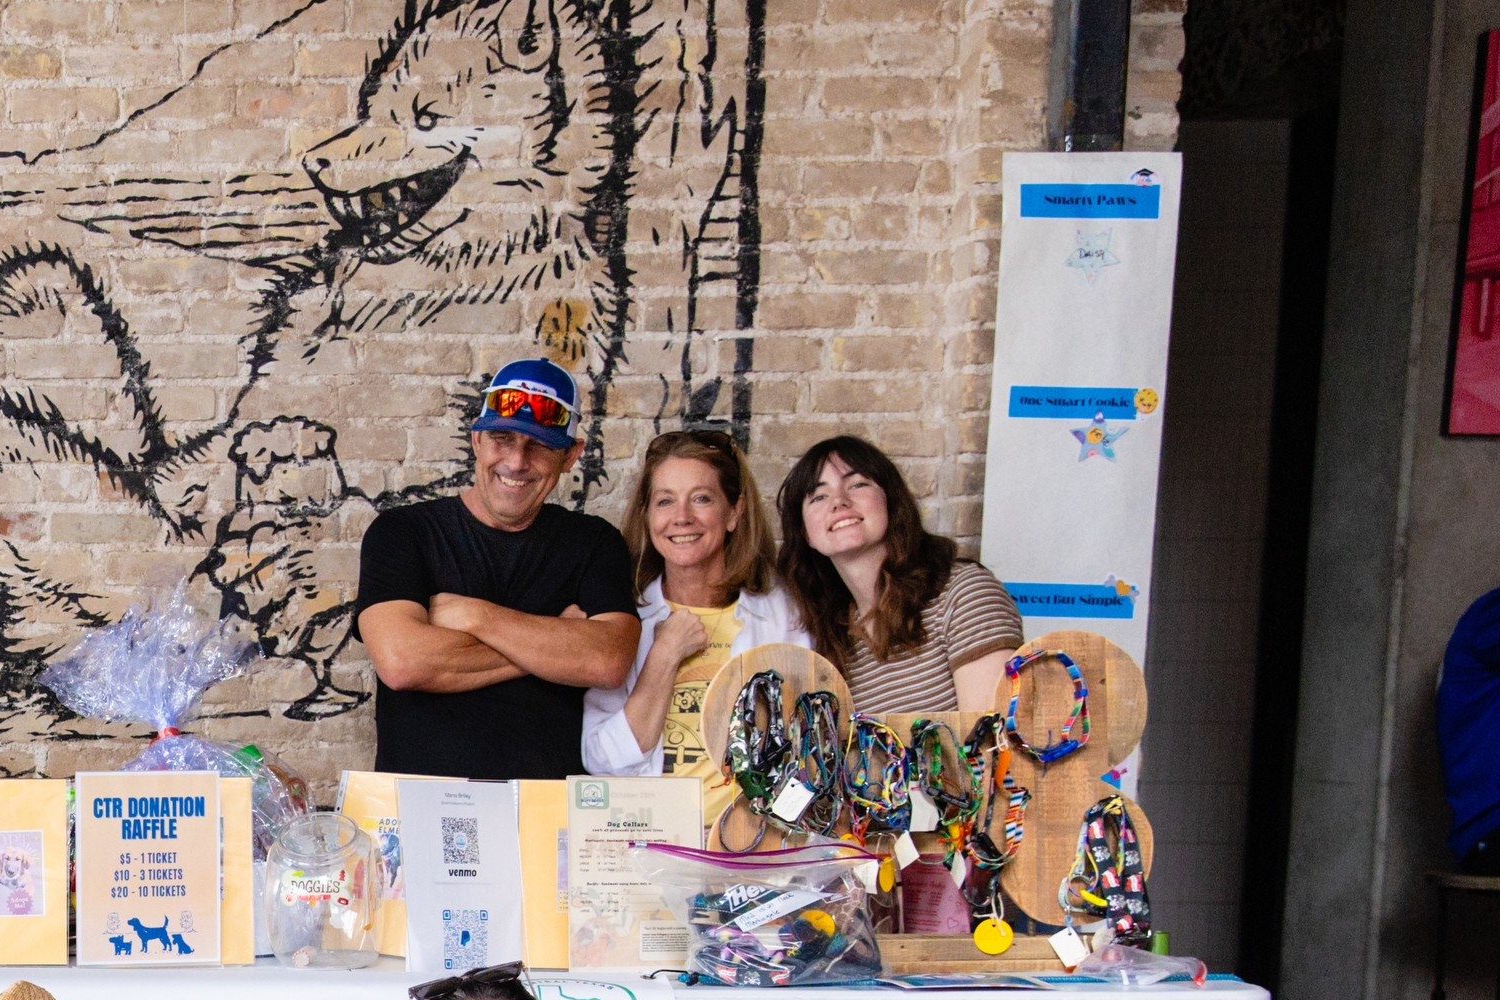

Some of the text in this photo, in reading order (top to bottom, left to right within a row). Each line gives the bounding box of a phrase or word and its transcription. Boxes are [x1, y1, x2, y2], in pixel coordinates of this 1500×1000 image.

[1043, 195, 1137, 208] Smarty Paws
[1019, 396, 1130, 408] One Smart Cookie
[1053, 594, 1076, 605] But
[1078, 594, 1125, 607] Simple
[93, 796, 205, 818] CTR DONATION
[122, 818, 177, 840] RAFFLE
[119, 852, 131, 865] $5
[140, 852, 145, 864] 1
[147, 852, 177, 864] TICKET
[114, 869, 130, 882] $10
[139, 869, 146, 881] 3
[148, 868, 183, 881] TICKETS
[448, 868, 478, 878] venmo
[111, 886, 129, 899] $20
[138, 886, 149, 898] 10
[151, 885, 186, 897] TICKETS
[10, 897, 29, 905] Adopt
